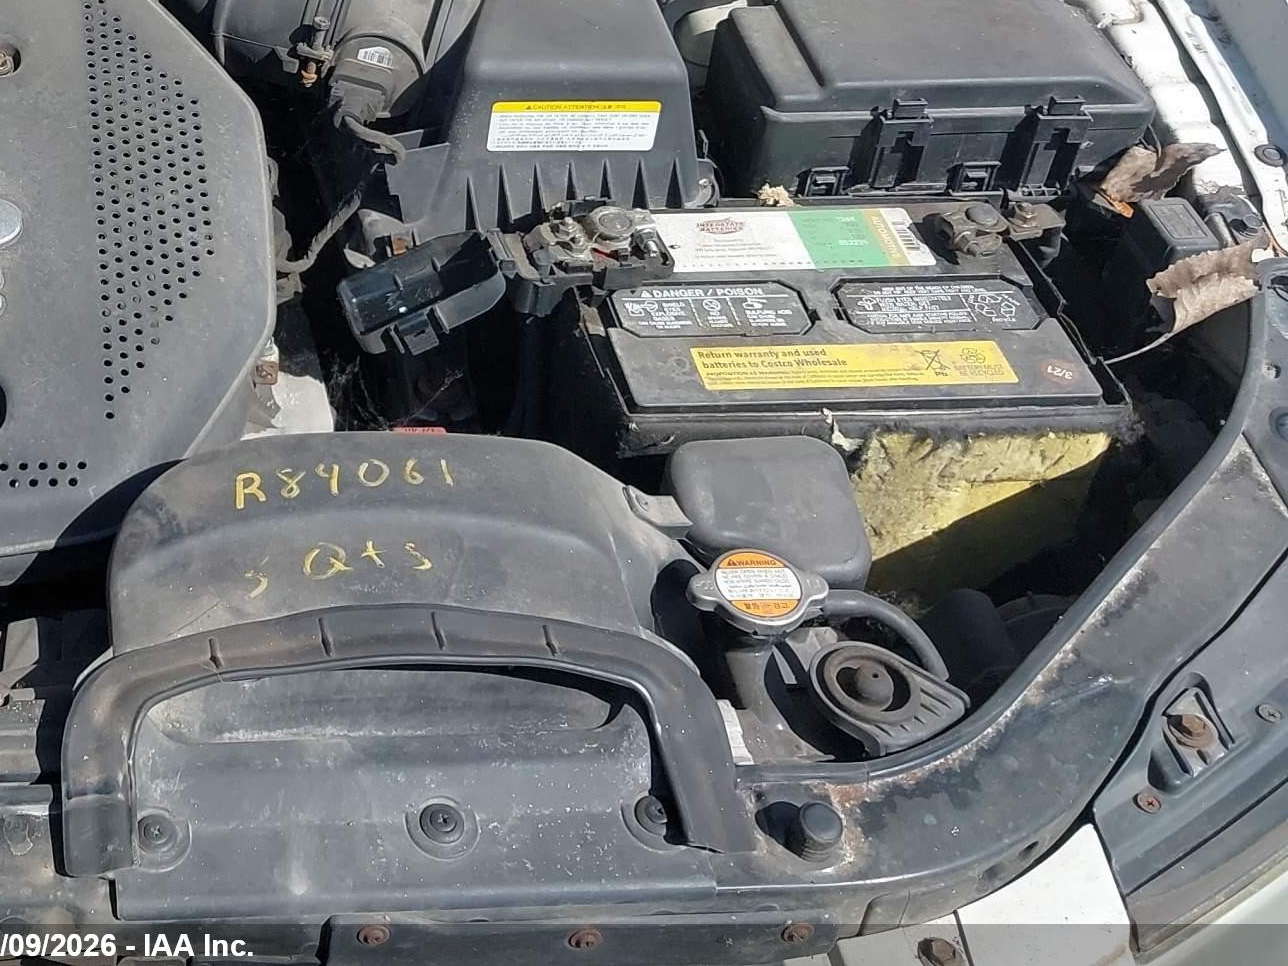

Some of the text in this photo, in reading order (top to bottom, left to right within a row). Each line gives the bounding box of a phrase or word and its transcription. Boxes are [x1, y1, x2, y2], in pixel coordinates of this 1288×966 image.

[653, 289, 705, 298] DANGER
[715, 288, 763, 296] POISON
[698, 348, 827, 359] Return warranty and used
[701, 357, 848, 369] batteries to Costco Wholesale
